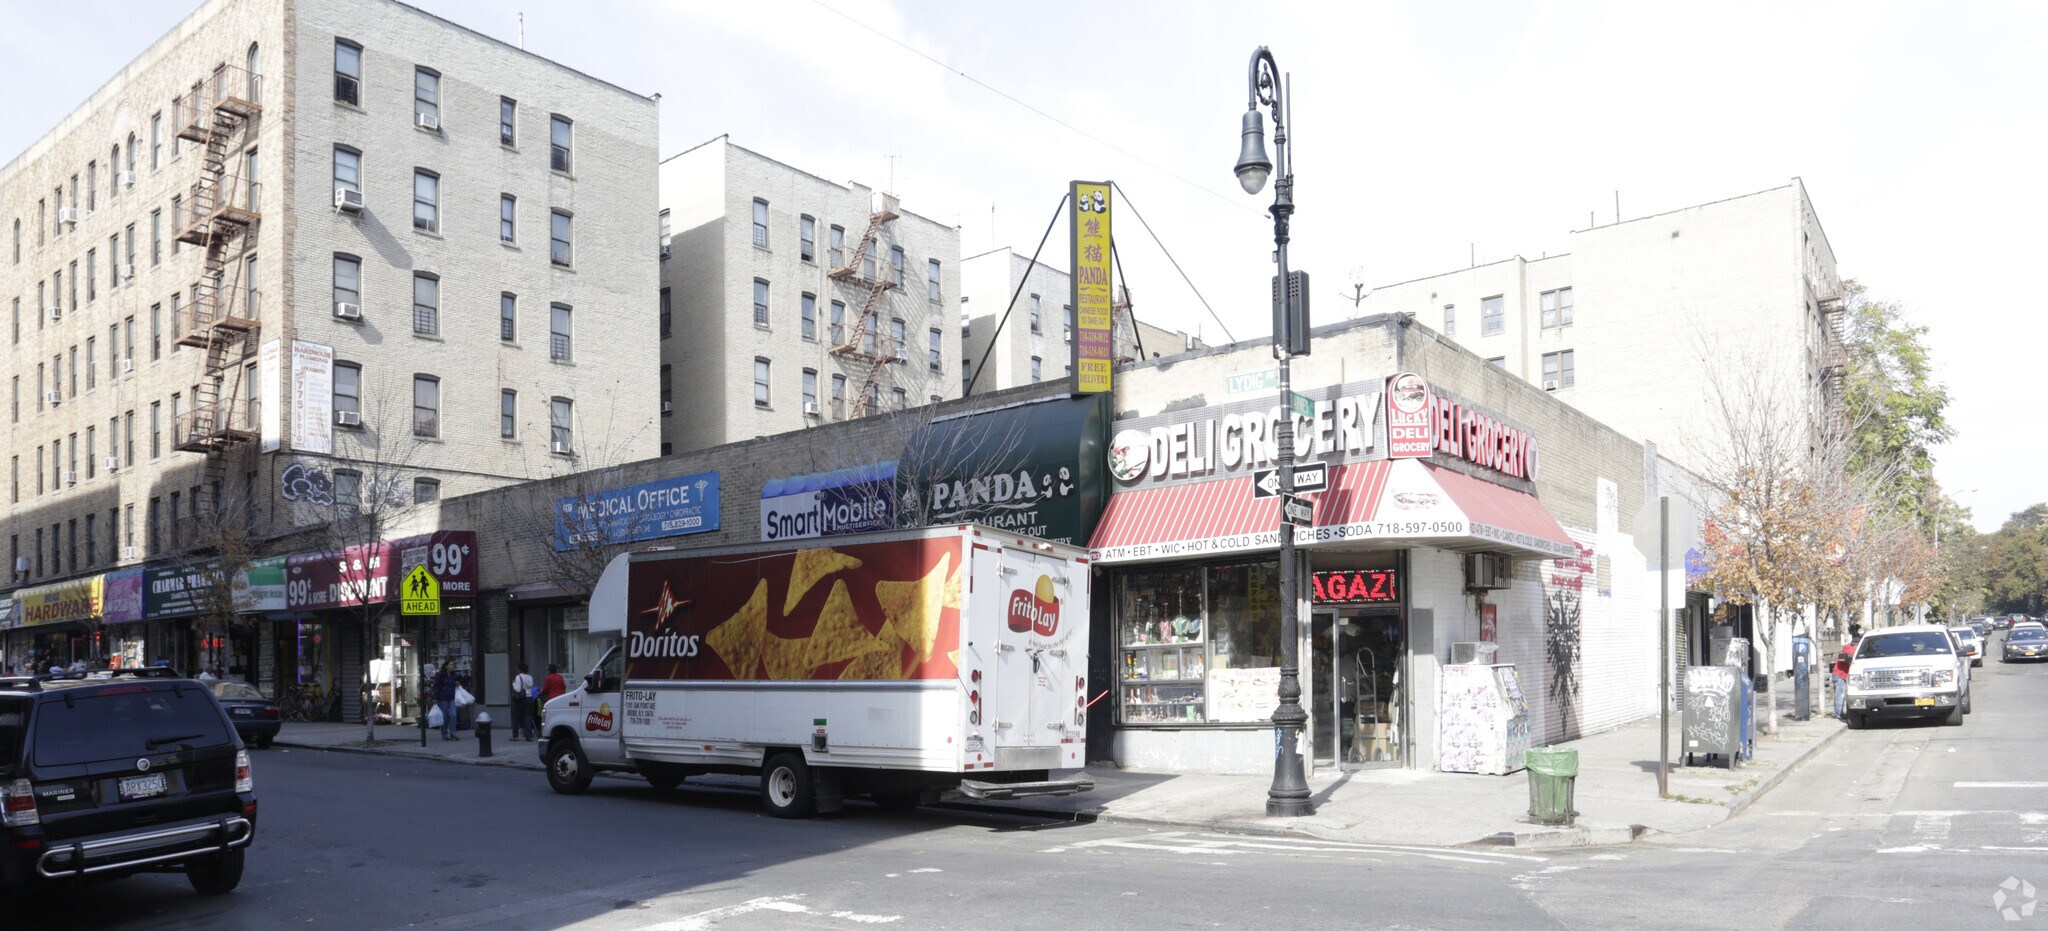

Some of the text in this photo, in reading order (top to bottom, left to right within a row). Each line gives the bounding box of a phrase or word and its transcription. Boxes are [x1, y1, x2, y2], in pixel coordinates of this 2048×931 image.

[1079, 266, 1107, 285] PANDA
[1079, 293, 1108, 305] RESTAURANT
[1079, 305, 1108, 316] CHINESE FOOD
[1087, 316, 1097, 325] TAKE
[1097, 317, 1107, 325] OUT
[1081, 362, 1107, 372] FREE
[1079, 374, 1108, 385] DELIVERY
[1229, 373, 1264, 394] LYDIG
[1391, 408, 1428, 424] LUCKY
[1151, 392, 1383, 476] DELI GROCERY
[1392, 428, 1428, 438] DELI
[1431, 394, 1527, 478] DELI GROCERY
[1392, 442, 1430, 452] GROCERY
[1297, 472, 1319, 484] WAY
[932, 470, 1037, 510] PANDA
[578, 485, 690, 520] MEDICAL OFFICE
[767, 504, 819, 539] Smart
[823, 496, 887, 532] Mobile
[1300, 507, 1310, 519] WAY
[1028, 525, 1048, 536] OUT
[1105, 547, 1125, 559] ATM
[1133, 546, 1151, 557] EBT
[1161, 542, 1180, 554] WIC
[1187, 539, 1208, 551] HOT
[1211, 539, 1218, 550] &
[1220, 536, 1250, 548] COLD
[1339, 524, 1374, 538] SODA
[1377, 521, 1463, 534] 718-597-0500
[339, 556, 380, 573] S & M
[329, 576, 388, 603] DISCOUNT
[442, 581, 470, 591] MORE
[313, 591, 327, 604] MORE
[25, 596, 99, 622] HARDWARE
[406, 601, 436, 612] AHEAD
[630, 628, 700, 658] Doritos
[625, 691, 657, 701] FRITO-LAY
[42, 787, 75, 797] MARINER
